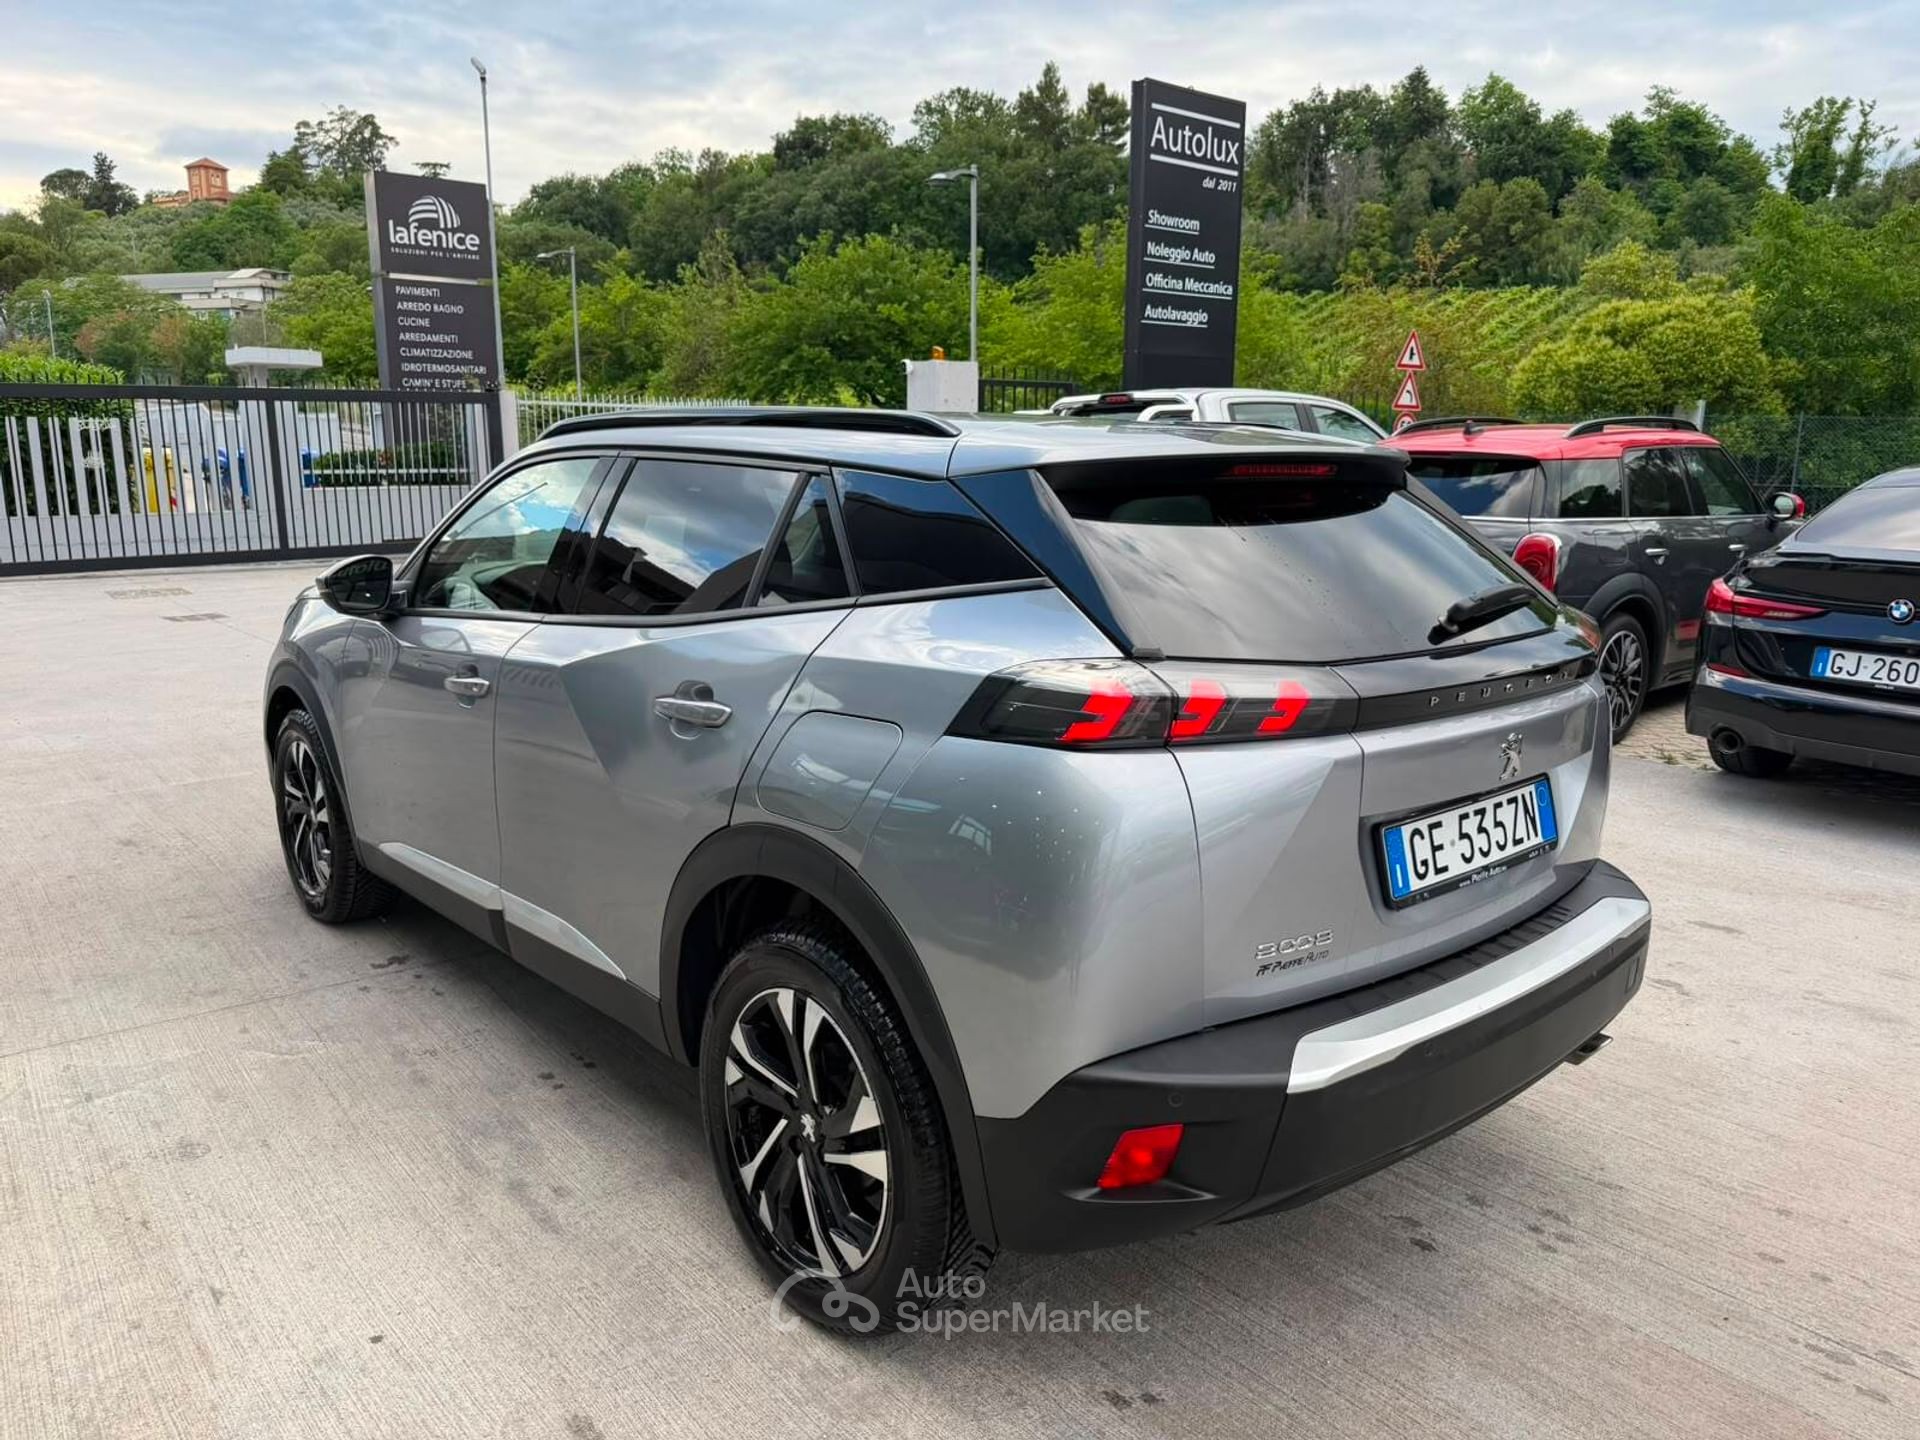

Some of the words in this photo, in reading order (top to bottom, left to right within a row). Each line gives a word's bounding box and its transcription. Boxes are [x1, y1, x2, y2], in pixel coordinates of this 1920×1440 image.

[1150, 115, 1239, 165] Autolux
[1202, 176, 1216, 190] dal
[1217, 178, 1238, 193] 2011
[1148, 209, 1200, 231] Showroom
[388, 219, 480, 251] lafenice
[1147, 241, 1191, 263] Noleggio
[1192, 247, 1216, 264] Auto
[395, 285, 441, 298] PAVIMENTI
[1146, 272, 1183, 291] Officina
[1184, 276, 1233, 296] Meccanica
[396, 301, 432, 313] ARREDO
[433, 303, 465, 315] BAGNO
[1144, 304, 1209, 325] Autolavaggio
[398, 316, 431, 328] CUCINE
[399, 332, 459, 344] ARREDAMENTI
[400, 347, 474, 360] CLIMATIZZAZIONE
[401, 362, 487, 375] IDROTERMOSANITARI
[1831, 652, 1863, 678] GJ
[1870, 658, 1920, 684] 260
[1410, 821, 1449, 881] GE
[1459, 791, 1538, 864] 535ZN
